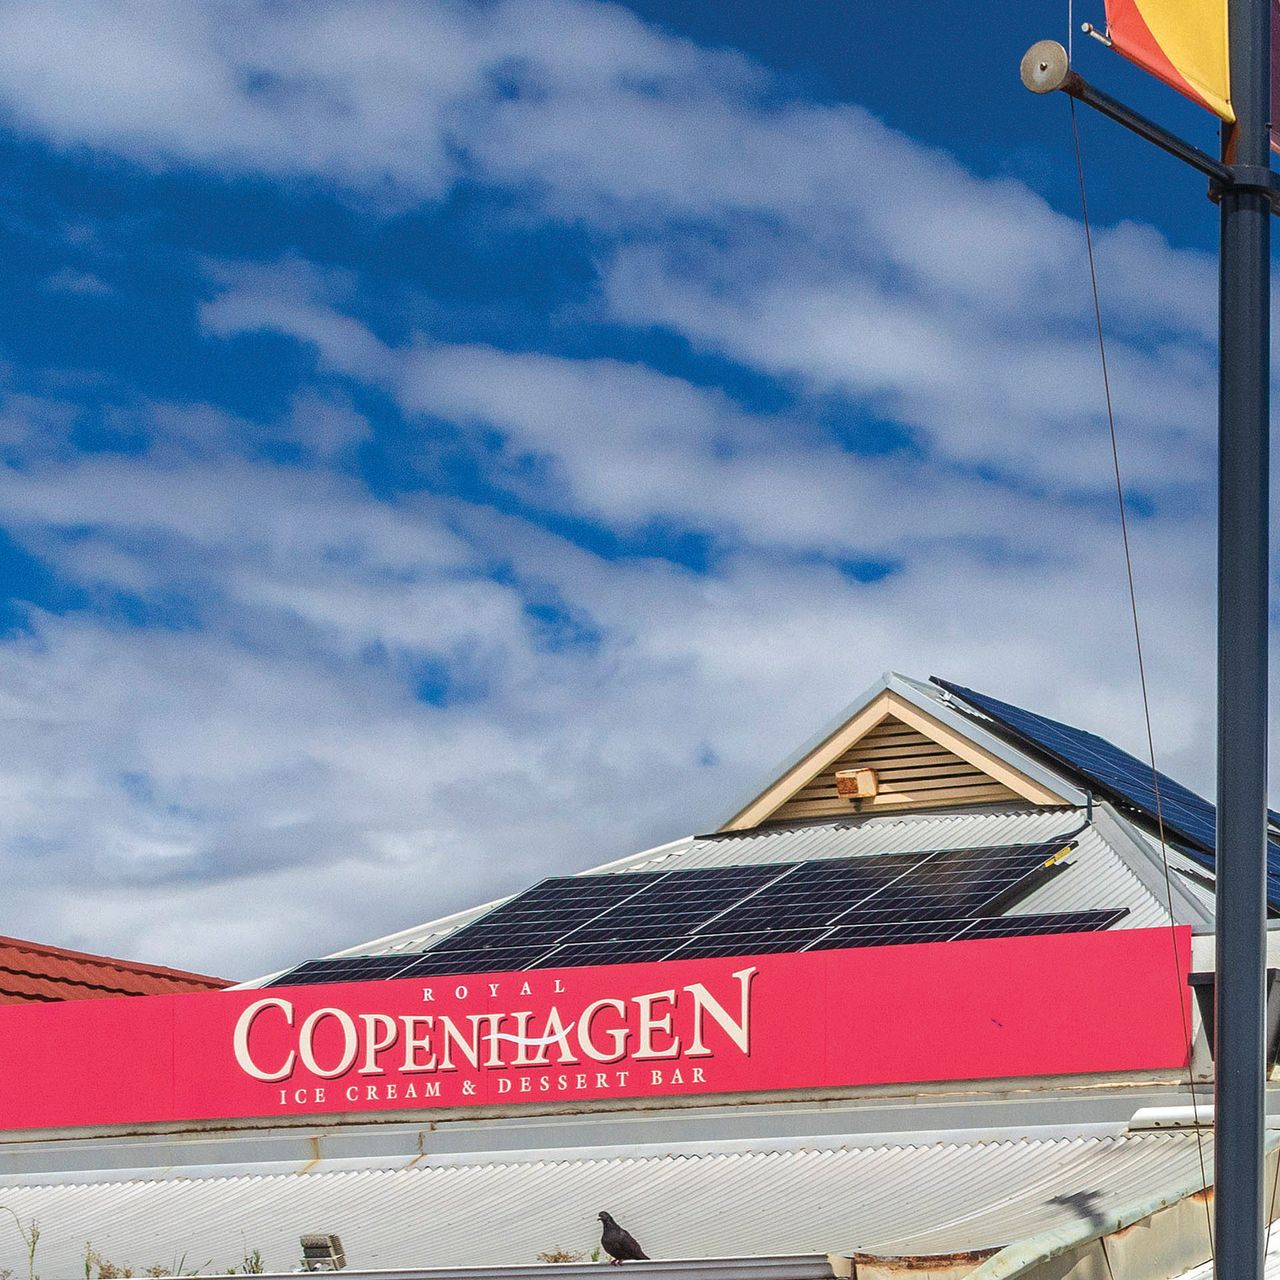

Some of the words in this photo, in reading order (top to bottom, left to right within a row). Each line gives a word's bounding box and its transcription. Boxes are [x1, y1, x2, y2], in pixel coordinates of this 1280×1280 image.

[423, 979, 565, 1003] ROYAL
[233, 965, 759, 1082] COPENHAGEN
[279, 1088, 326, 1105] ICE
[346, 1081, 441, 1101] CREAM
[462, 1080, 476, 1096] &
[498, 1071, 629, 1093] DESSERT
[650, 1067, 706, 1085] BAR
